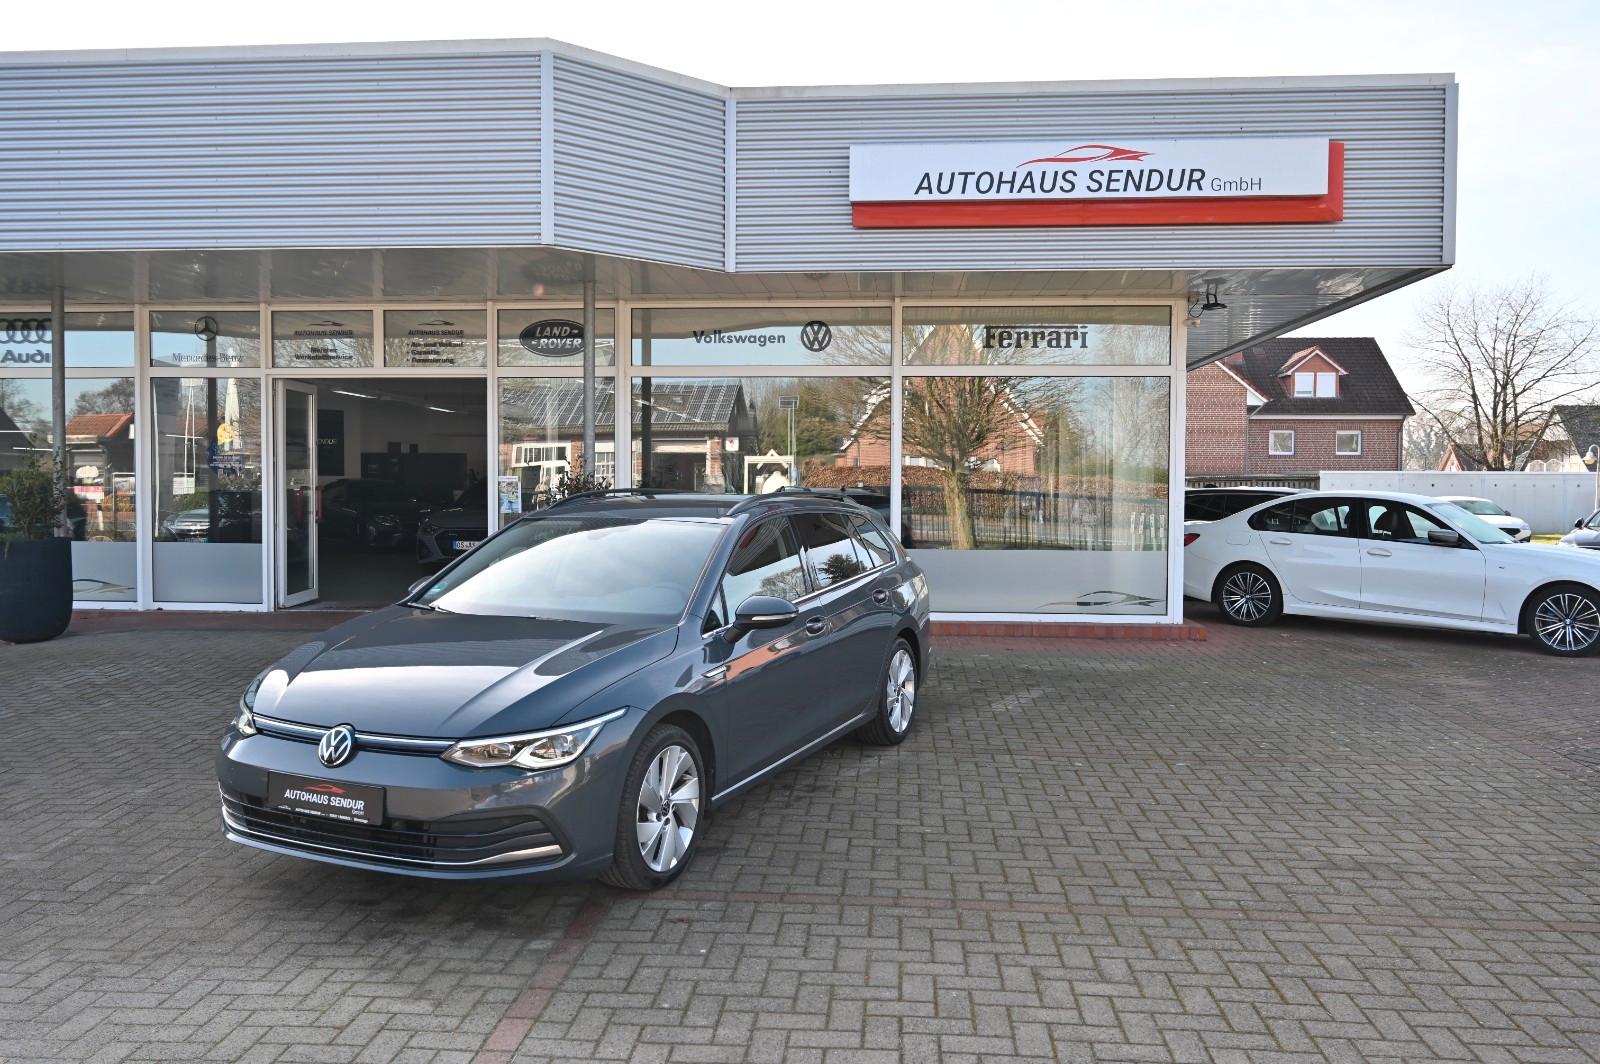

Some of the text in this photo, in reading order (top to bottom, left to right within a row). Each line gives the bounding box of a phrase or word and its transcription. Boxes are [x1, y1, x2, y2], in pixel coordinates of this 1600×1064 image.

[915, 168, 1263, 194] AUTOHAUS SENDUR GmbH
[535, 326, 570, 338] LAND
[692, 330, 786, 347] Volkswagen
[983, 325, 1089, 349] Ferrari
[537, 338, 582, 349] ROVER
[1, 349, 51, 364] Audi
[172, 352, 245, 363] Mercedes-Benz
[284, 789, 364, 810] AUTOHAUS SENDUR
